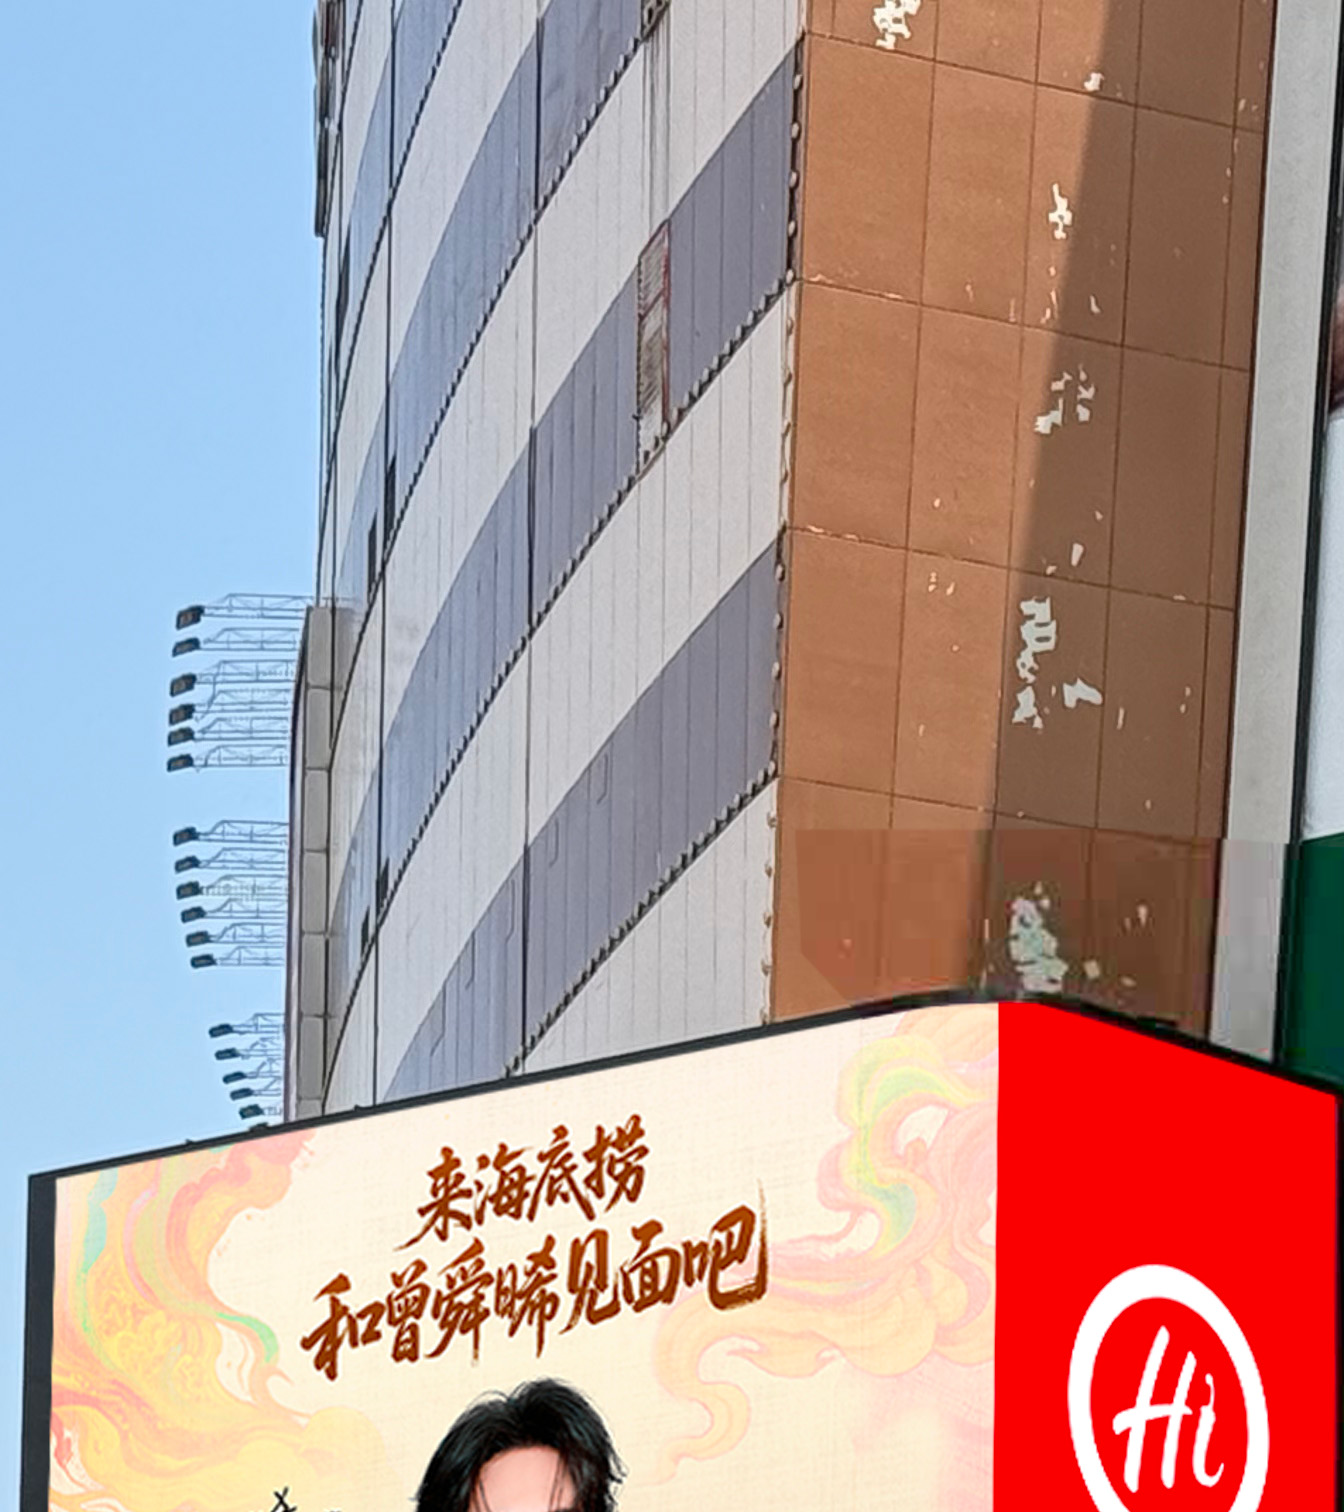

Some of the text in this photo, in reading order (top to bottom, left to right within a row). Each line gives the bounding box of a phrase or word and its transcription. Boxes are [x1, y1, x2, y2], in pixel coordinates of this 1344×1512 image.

[397, 1114, 649, 1251] 来海底捞
[300, 1178, 768, 1380] 和曾舜晞见面吧
[1112, 1325, 1224, 1493] Hi
